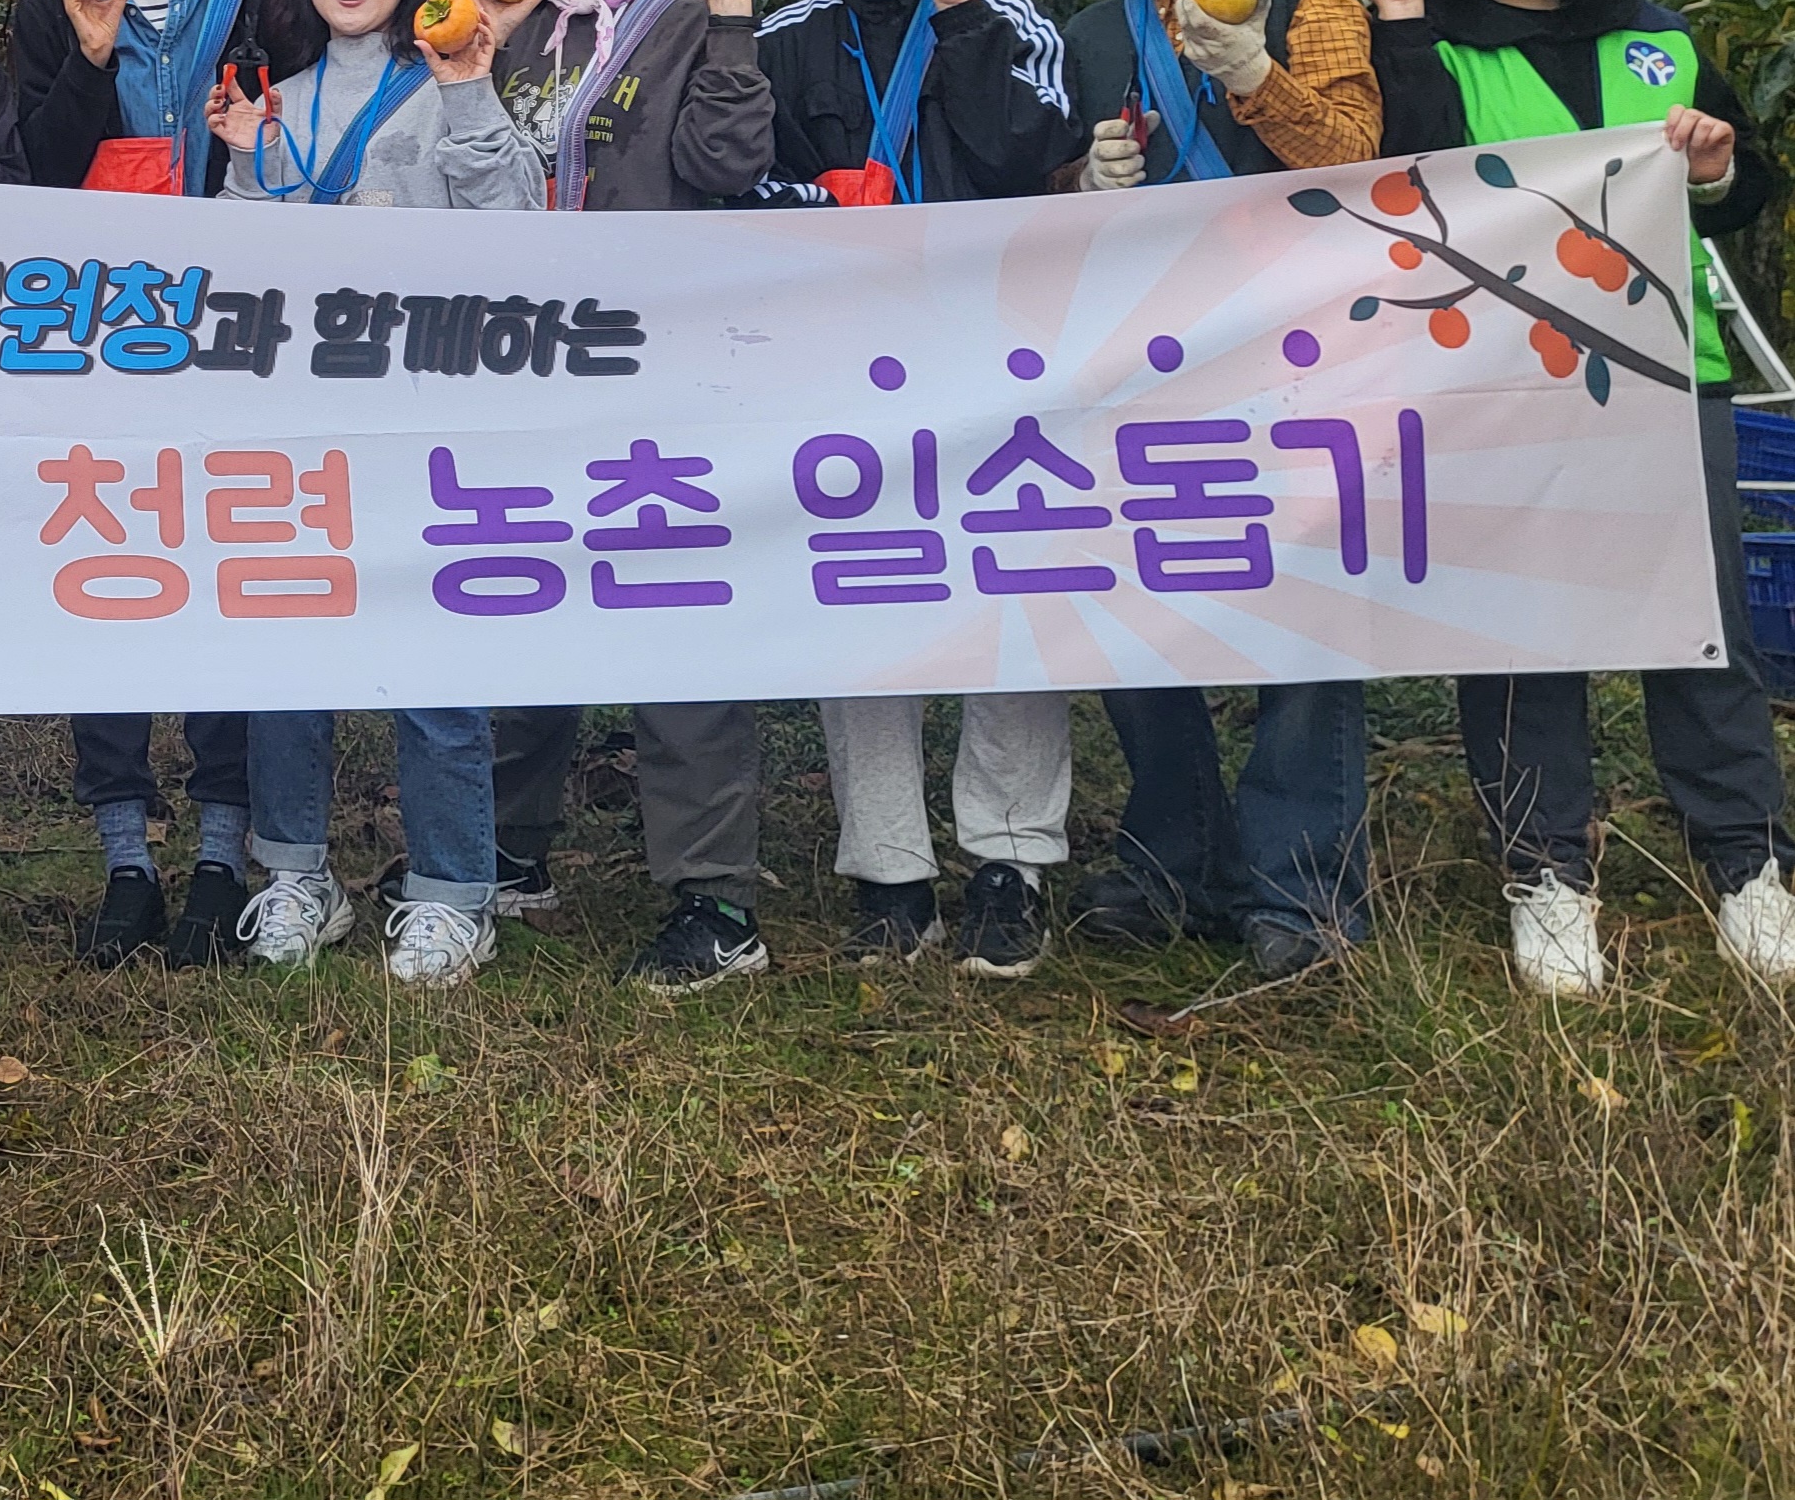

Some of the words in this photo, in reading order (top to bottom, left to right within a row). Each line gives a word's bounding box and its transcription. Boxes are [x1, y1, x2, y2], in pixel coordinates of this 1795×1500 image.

[588, 115, 613, 128] WITH
[310, 286, 648, 379] 함께하는
[37, 443, 359, 620] 청렴
[421, 437, 734, 617] 농촌
[791, 408, 1429, 606] 일손돕기
